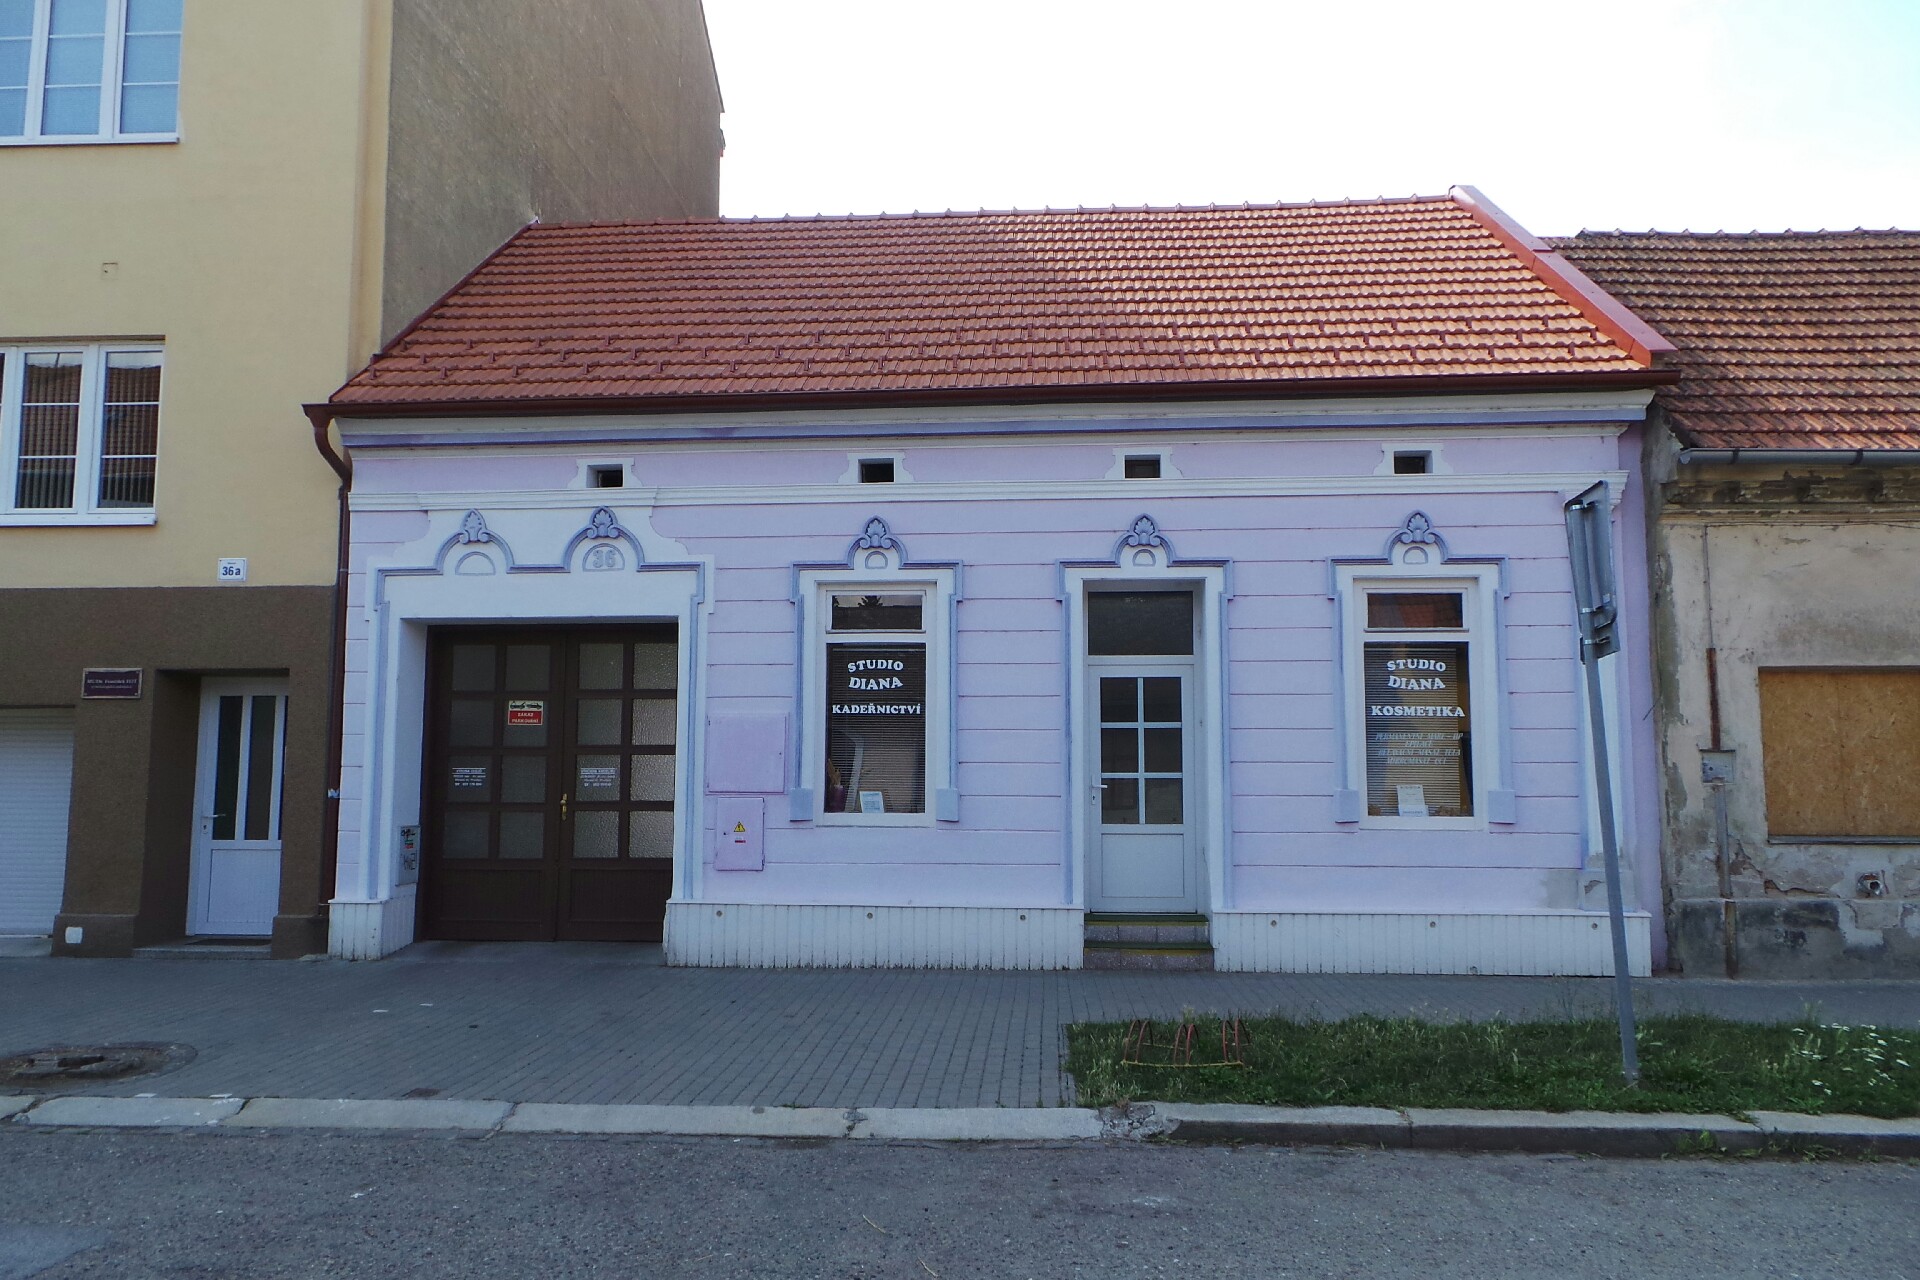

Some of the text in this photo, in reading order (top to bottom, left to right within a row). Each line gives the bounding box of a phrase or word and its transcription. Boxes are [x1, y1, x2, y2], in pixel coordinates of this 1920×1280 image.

[592, 549, 616, 568] 36
[222, 566, 241, 576] 36a
[847, 659, 904, 672] STUDIO
[1386, 658, 1447, 672] STUDIO
[848, 676, 904, 690] DIANA
[1387, 675, 1446, 690] DIANA
[831, 703, 921, 714] KADEŘNICTVÍ
[1371, 705, 1466, 717] KOSMETIKA
